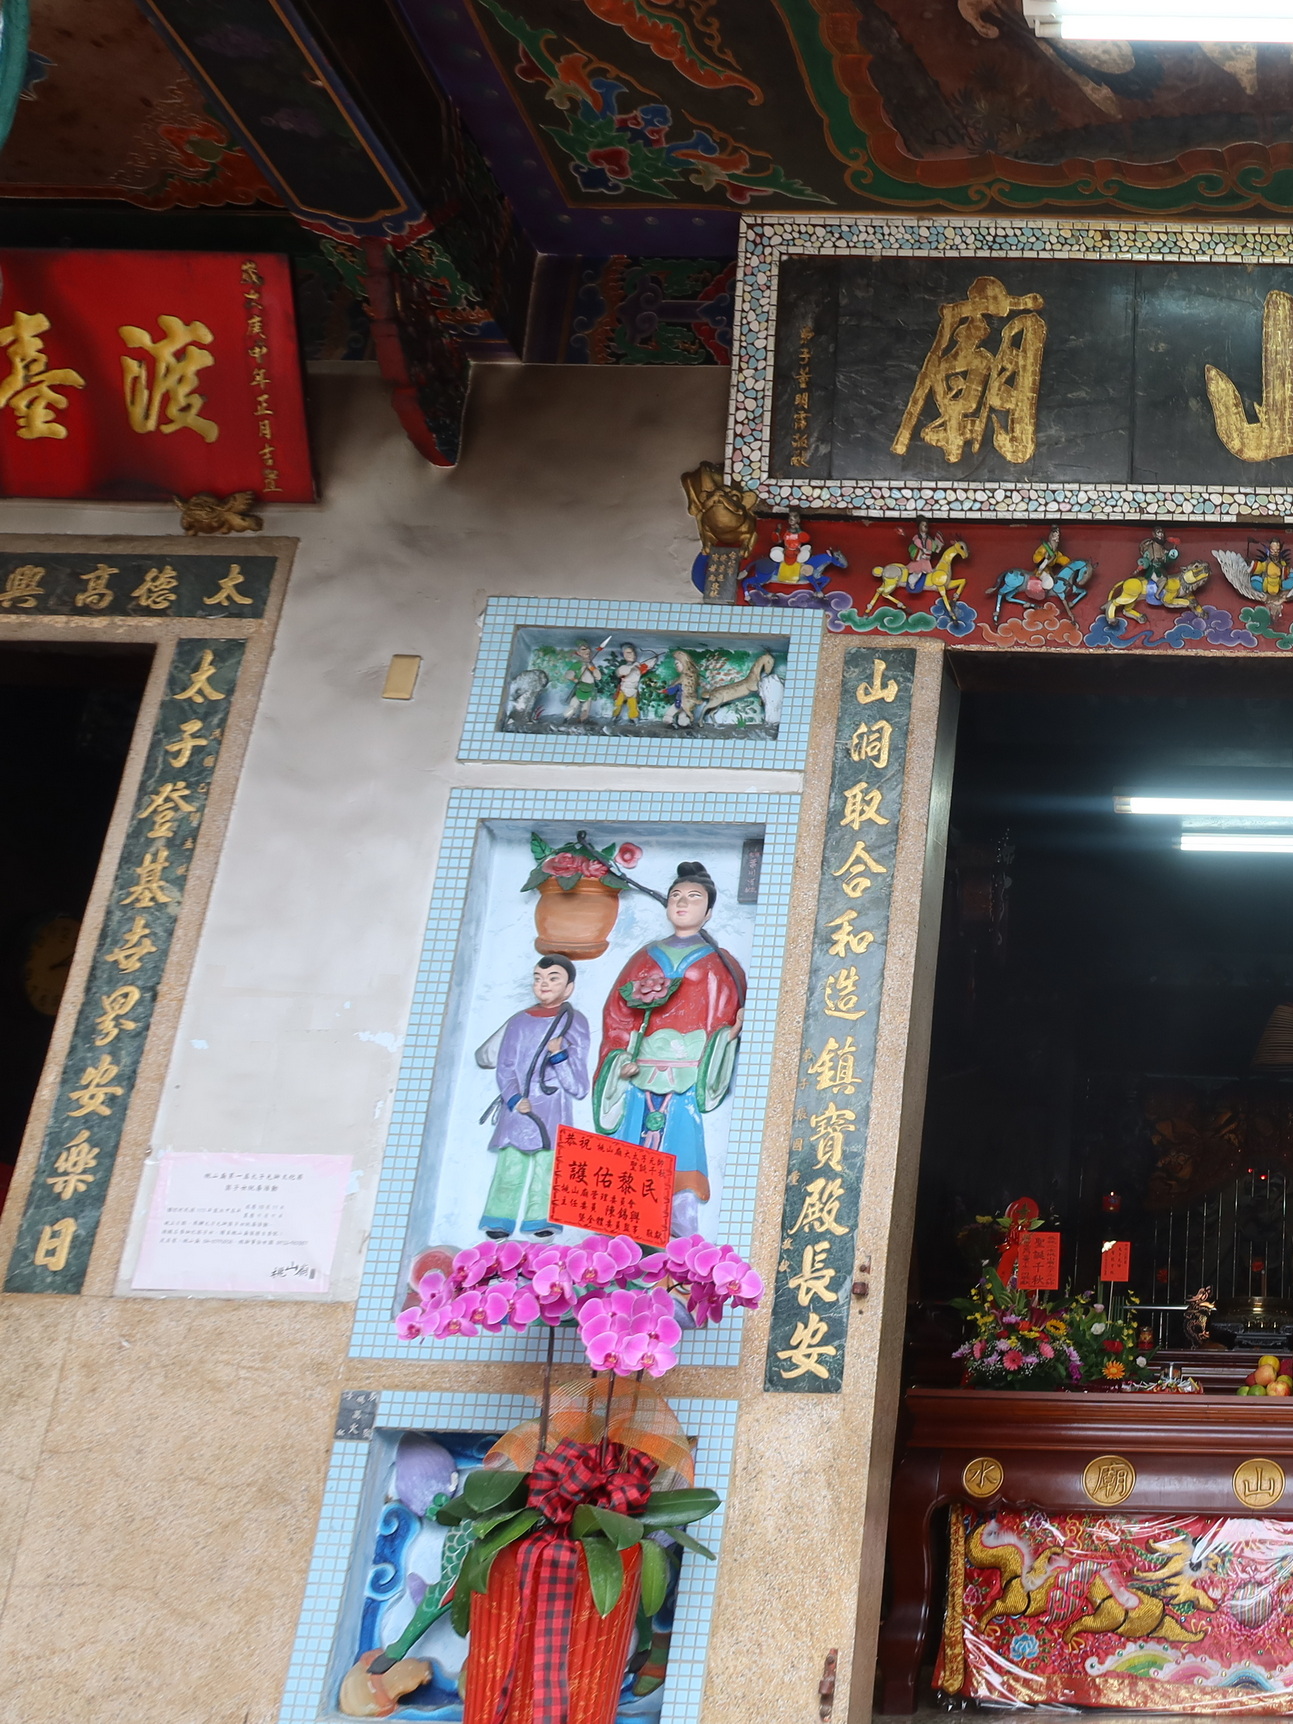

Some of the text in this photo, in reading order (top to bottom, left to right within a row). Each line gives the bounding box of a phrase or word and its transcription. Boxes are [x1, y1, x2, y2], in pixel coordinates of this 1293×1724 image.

[565, 1133, 593, 1152] 恭祝
[568, 1160, 660, 1204] 護佑黎民
